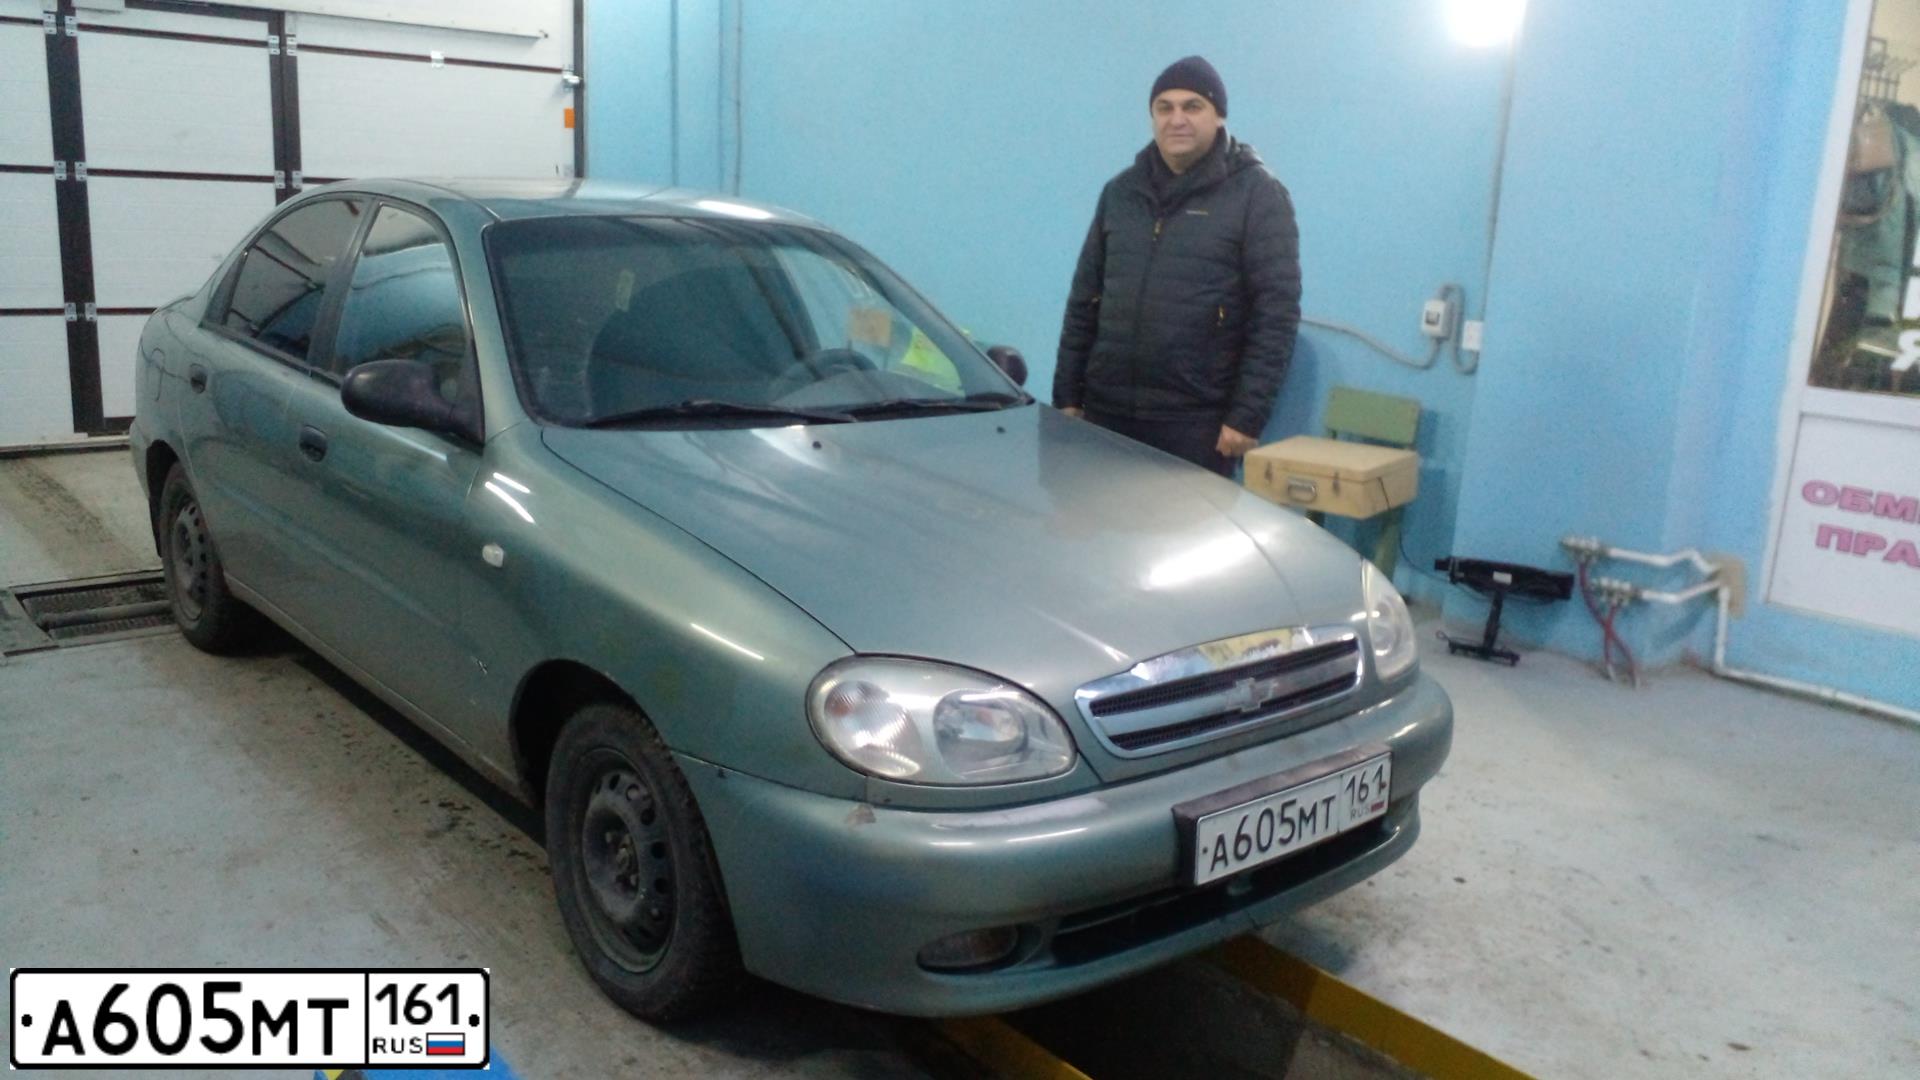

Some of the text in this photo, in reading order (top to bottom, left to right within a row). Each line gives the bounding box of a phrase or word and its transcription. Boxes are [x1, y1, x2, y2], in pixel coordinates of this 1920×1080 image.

[1802, 480, 1920, 524] ОБМ
[1209, 764, 1383, 872] А605МТ 161
